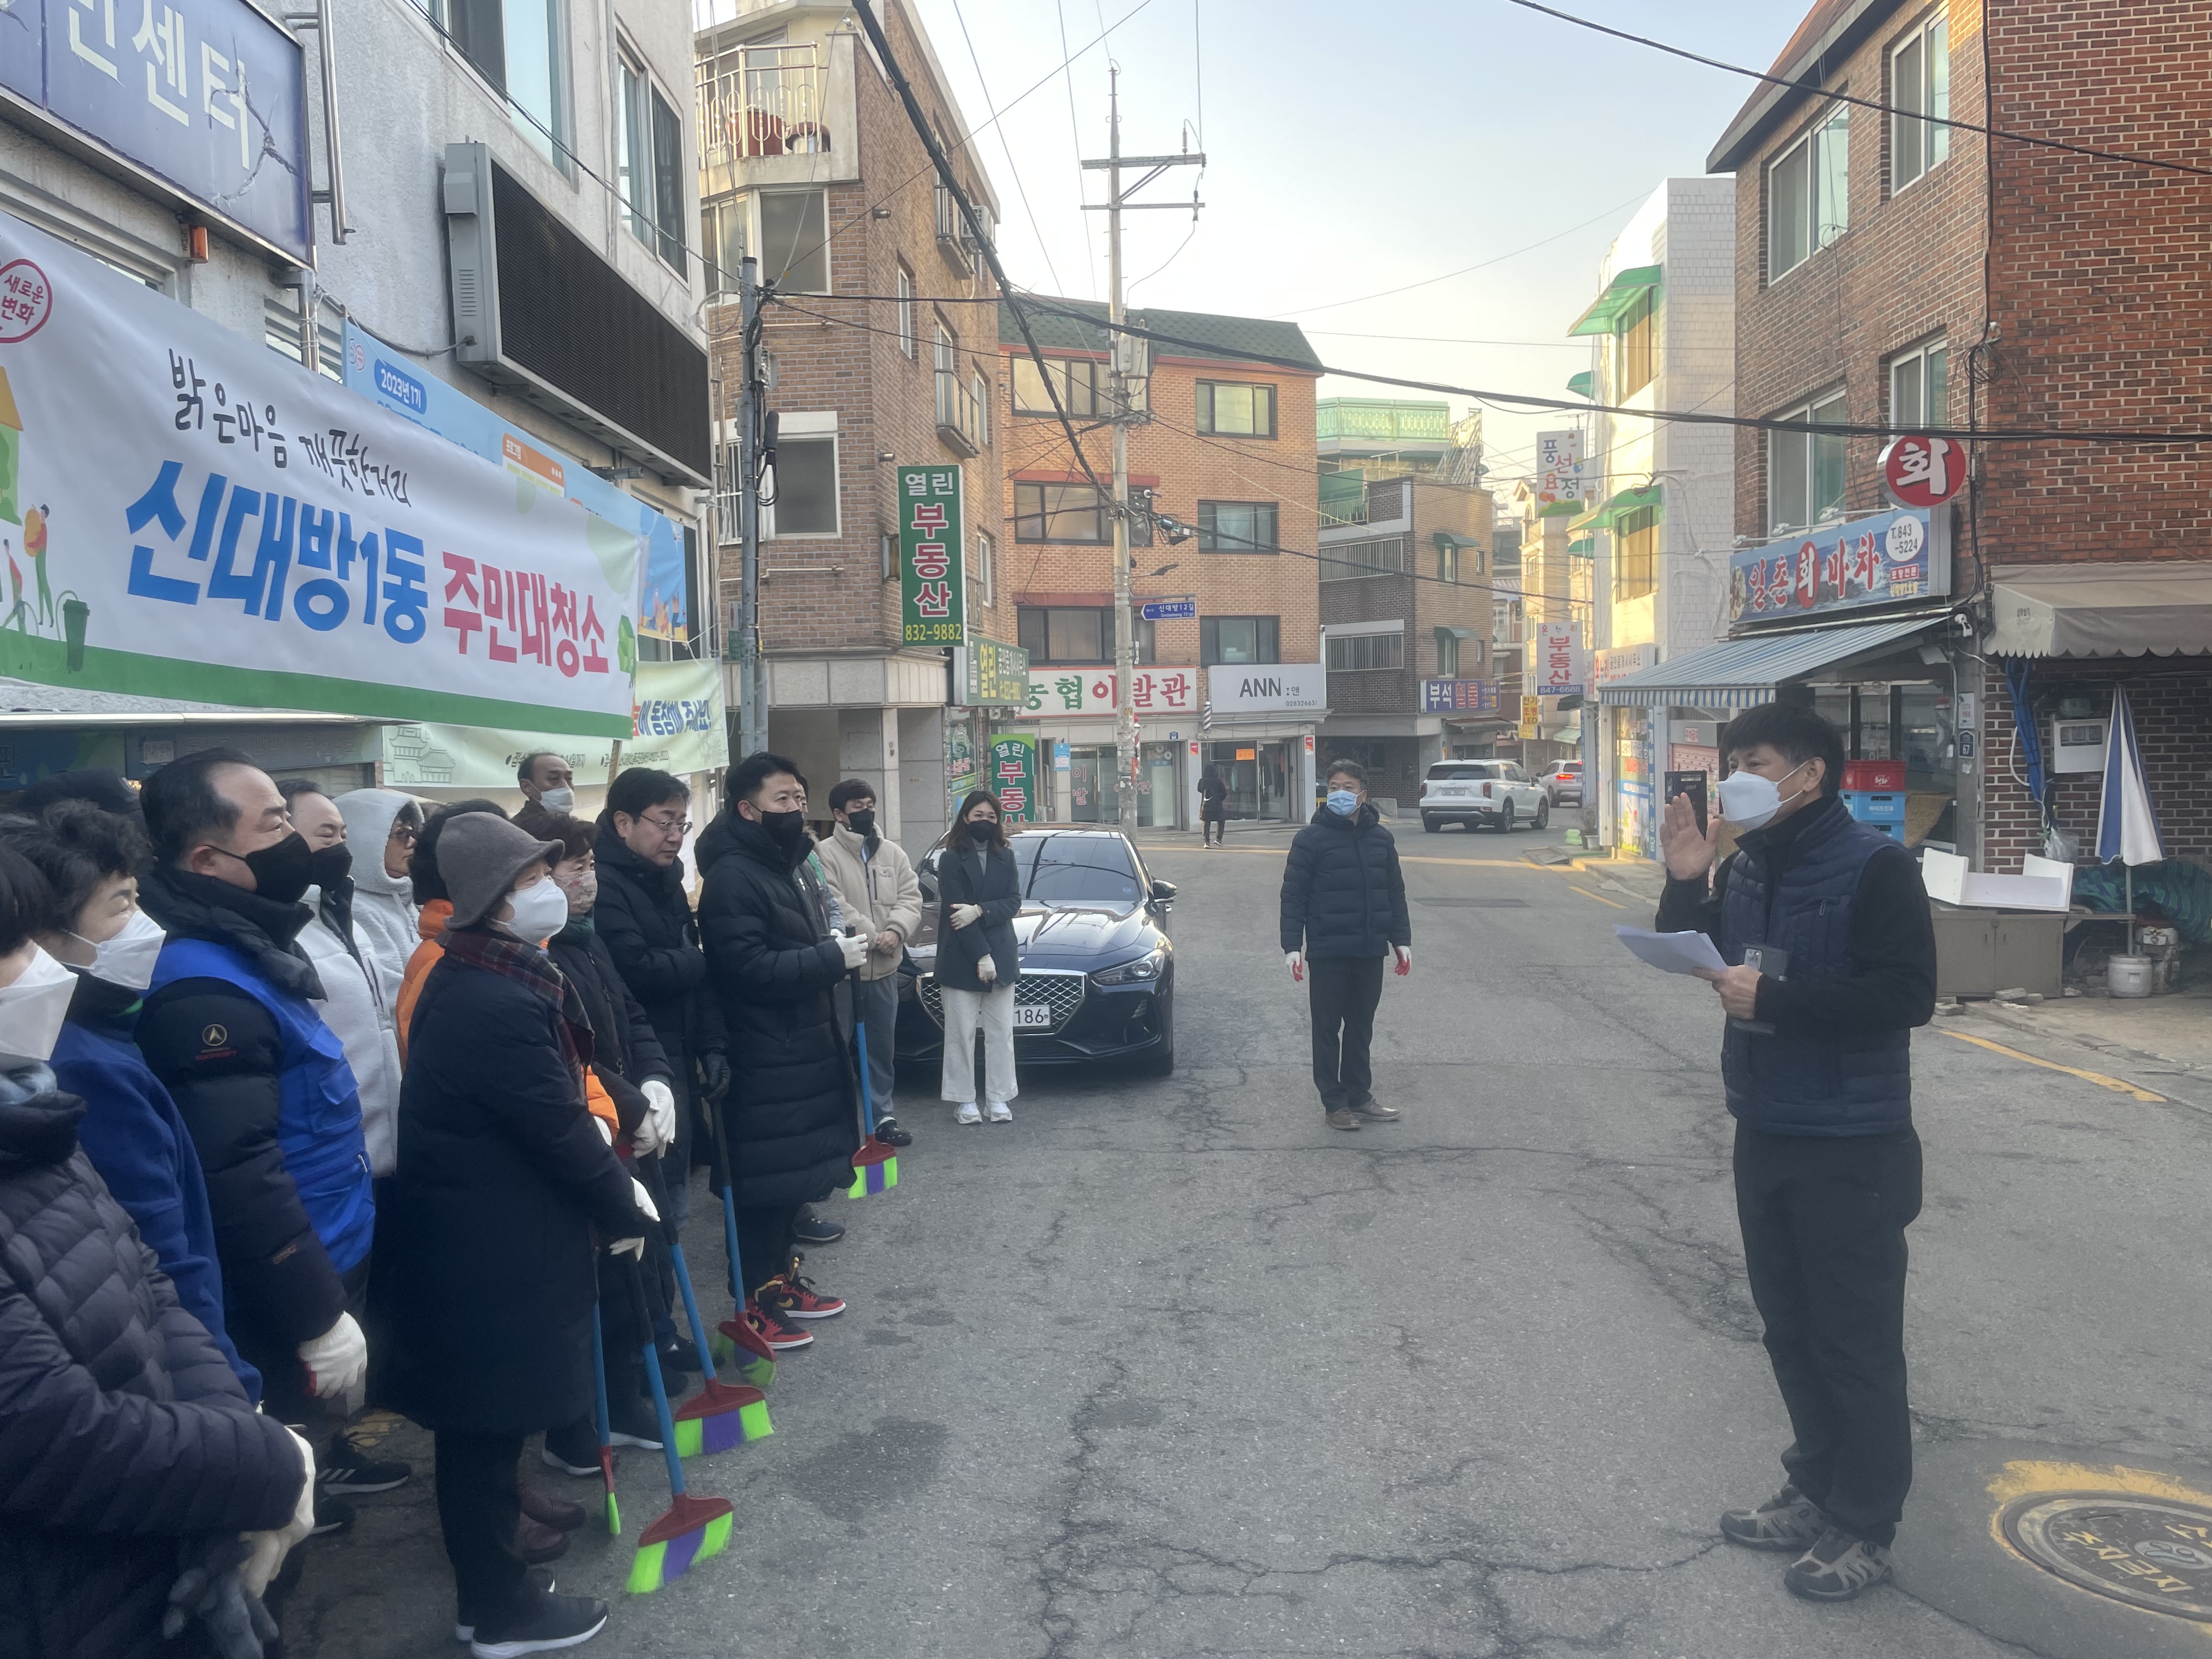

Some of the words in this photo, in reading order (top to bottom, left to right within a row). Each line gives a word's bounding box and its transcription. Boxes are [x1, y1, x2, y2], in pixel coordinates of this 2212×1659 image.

[4, 274, 44, 304] 새로운
[2, 295, 35, 325] 변화
[381, 368, 409, 404] 2023년
[410, 385, 421, 409] 1기
[168, 348, 289, 469] 밝은마음
[298, 429, 411, 508] 깨끗한거리
[1896, 438, 1949, 495] 회
[905, 472, 954, 496] 열린
[1891, 523, 1912, 539] T.843
[1895, 538, 1918, 554] -5224
[126, 460, 428, 645] 신대방1동
[442, 551, 610, 678] 주민대청소
[911, 503, 953, 618] 부동산
[1159, 603, 1194, 612] 신대방12길
[905, 623, 962, 641] 832-9882
[980, 643, 997, 698] 열린
[1548, 636, 1572, 685] 부동산
[1239, 676, 1282, 697] ANN
[1430, 684, 1452, 709] 부석
[1540, 686, 1581, 695] 847-6688
[1523, 697, 1537, 706] 전기
[1523, 707, 1538, 716] 조명
[995, 742, 1025, 758] 열린
[1962, 744, 1970, 755] 67
[1014, 1008, 1044, 1024] 186
